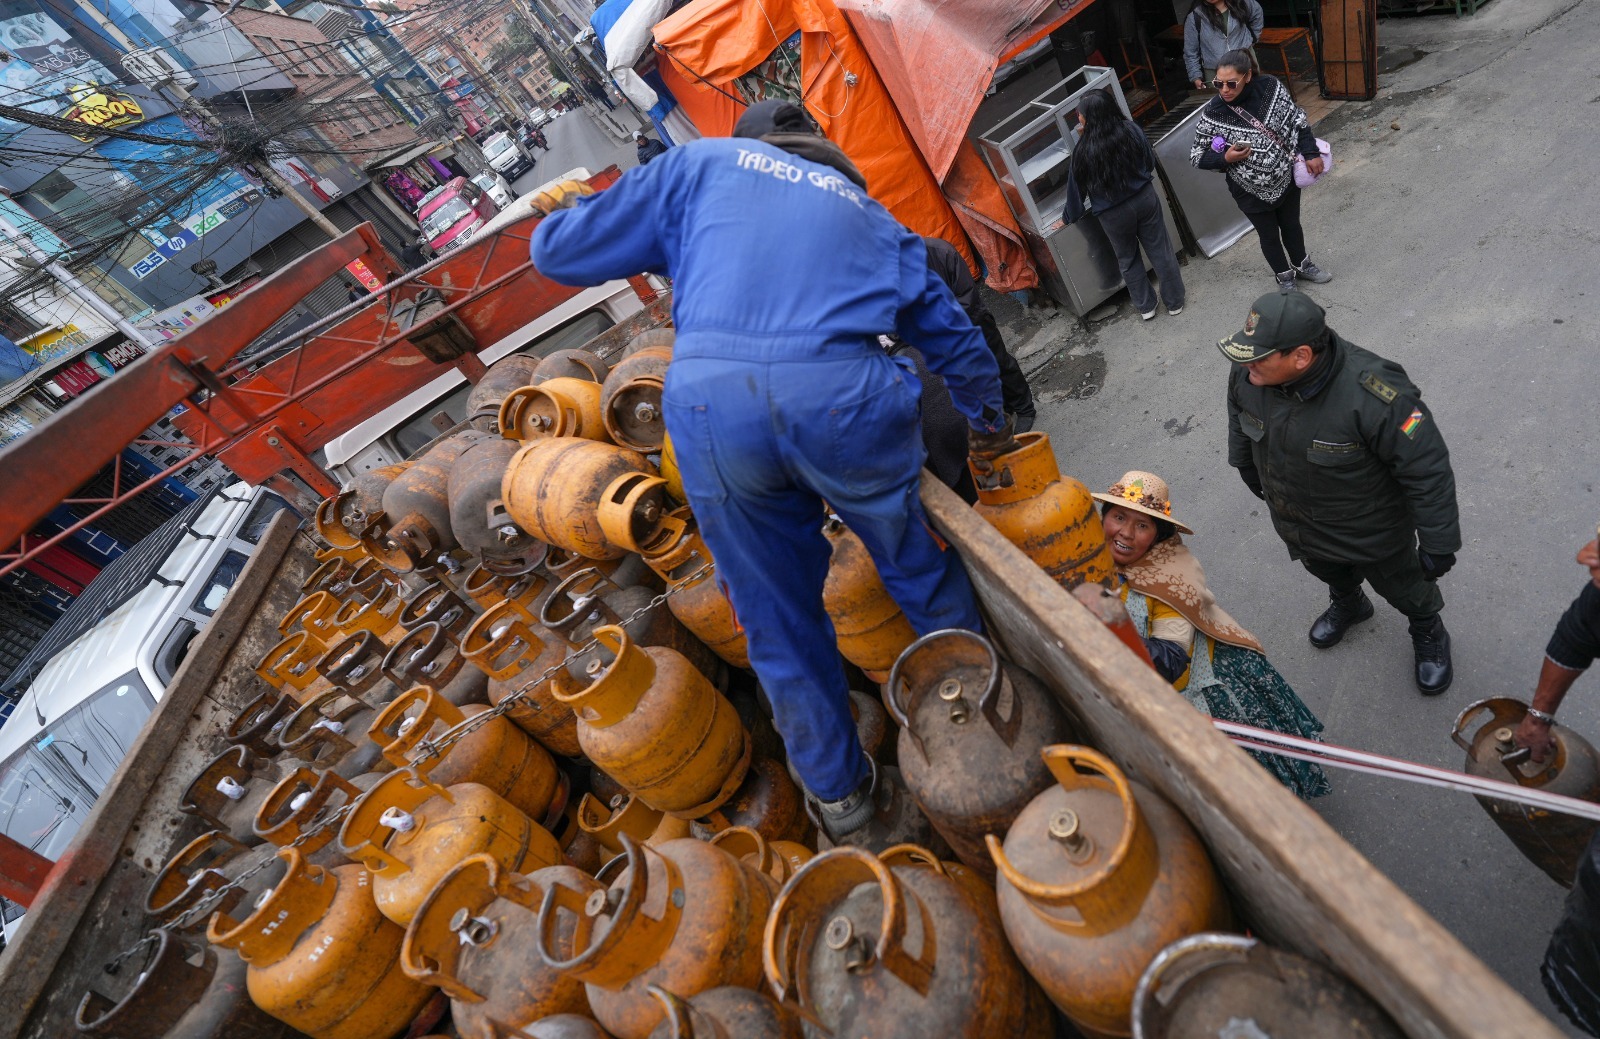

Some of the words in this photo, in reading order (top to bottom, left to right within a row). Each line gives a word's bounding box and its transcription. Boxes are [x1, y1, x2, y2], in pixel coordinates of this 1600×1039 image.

[737, 148, 803, 183] TADEO
[807, 171, 846, 197] GAS
[192, 211, 222, 236] acer
[133, 251, 163, 278] ASUS
